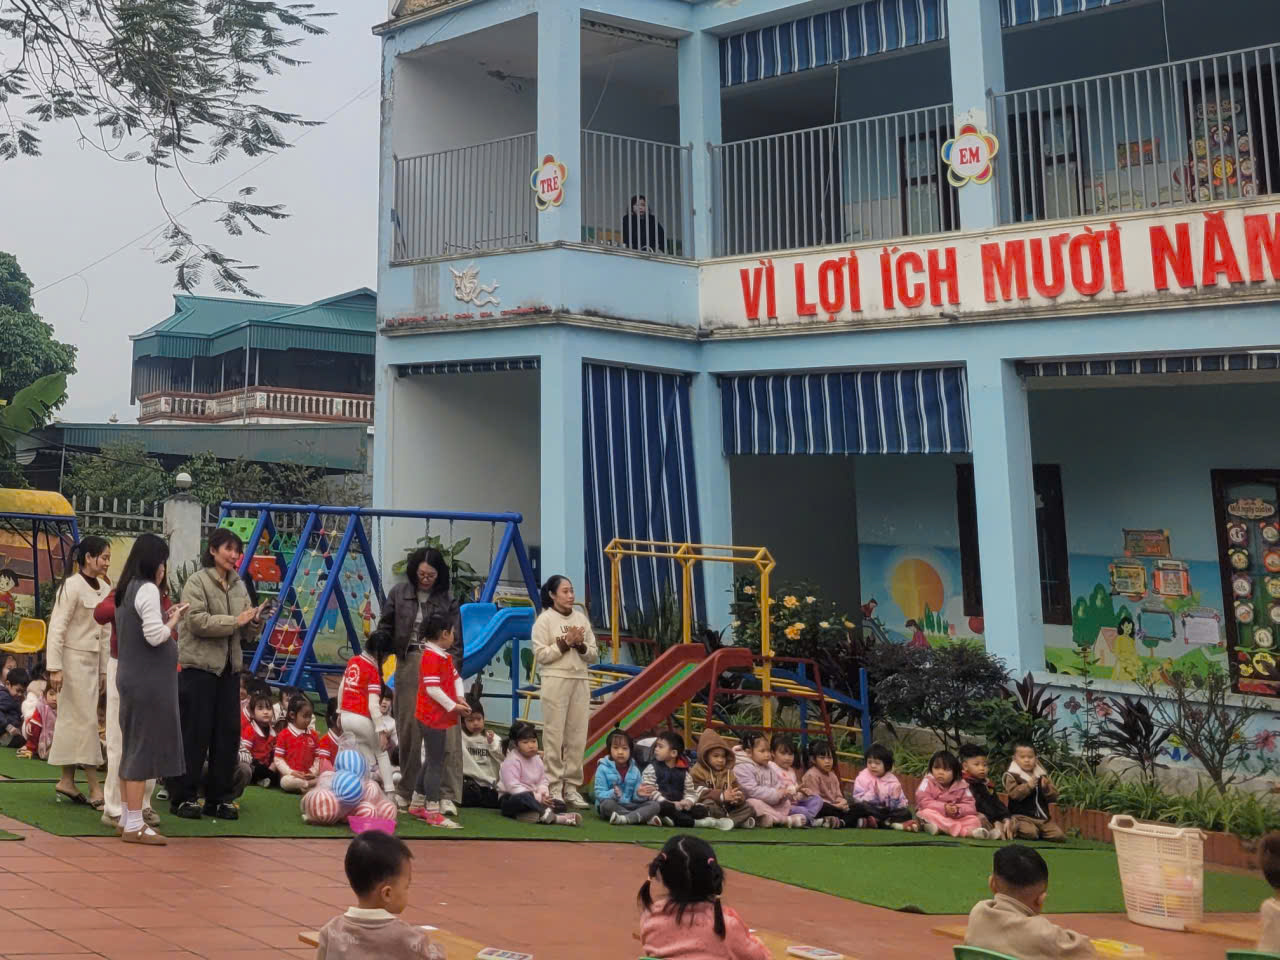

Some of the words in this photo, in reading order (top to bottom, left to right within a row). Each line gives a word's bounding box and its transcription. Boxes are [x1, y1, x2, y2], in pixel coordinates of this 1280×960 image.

[959, 146, 981, 165] EM
[540, 169, 560, 194] TRẺ
[739, 258, 777, 320] VÌ
[794, 250, 862, 322] LỢI
[880, 246, 960, 310] ÍCH
[980, 221, 1126, 303] MƯỜI
